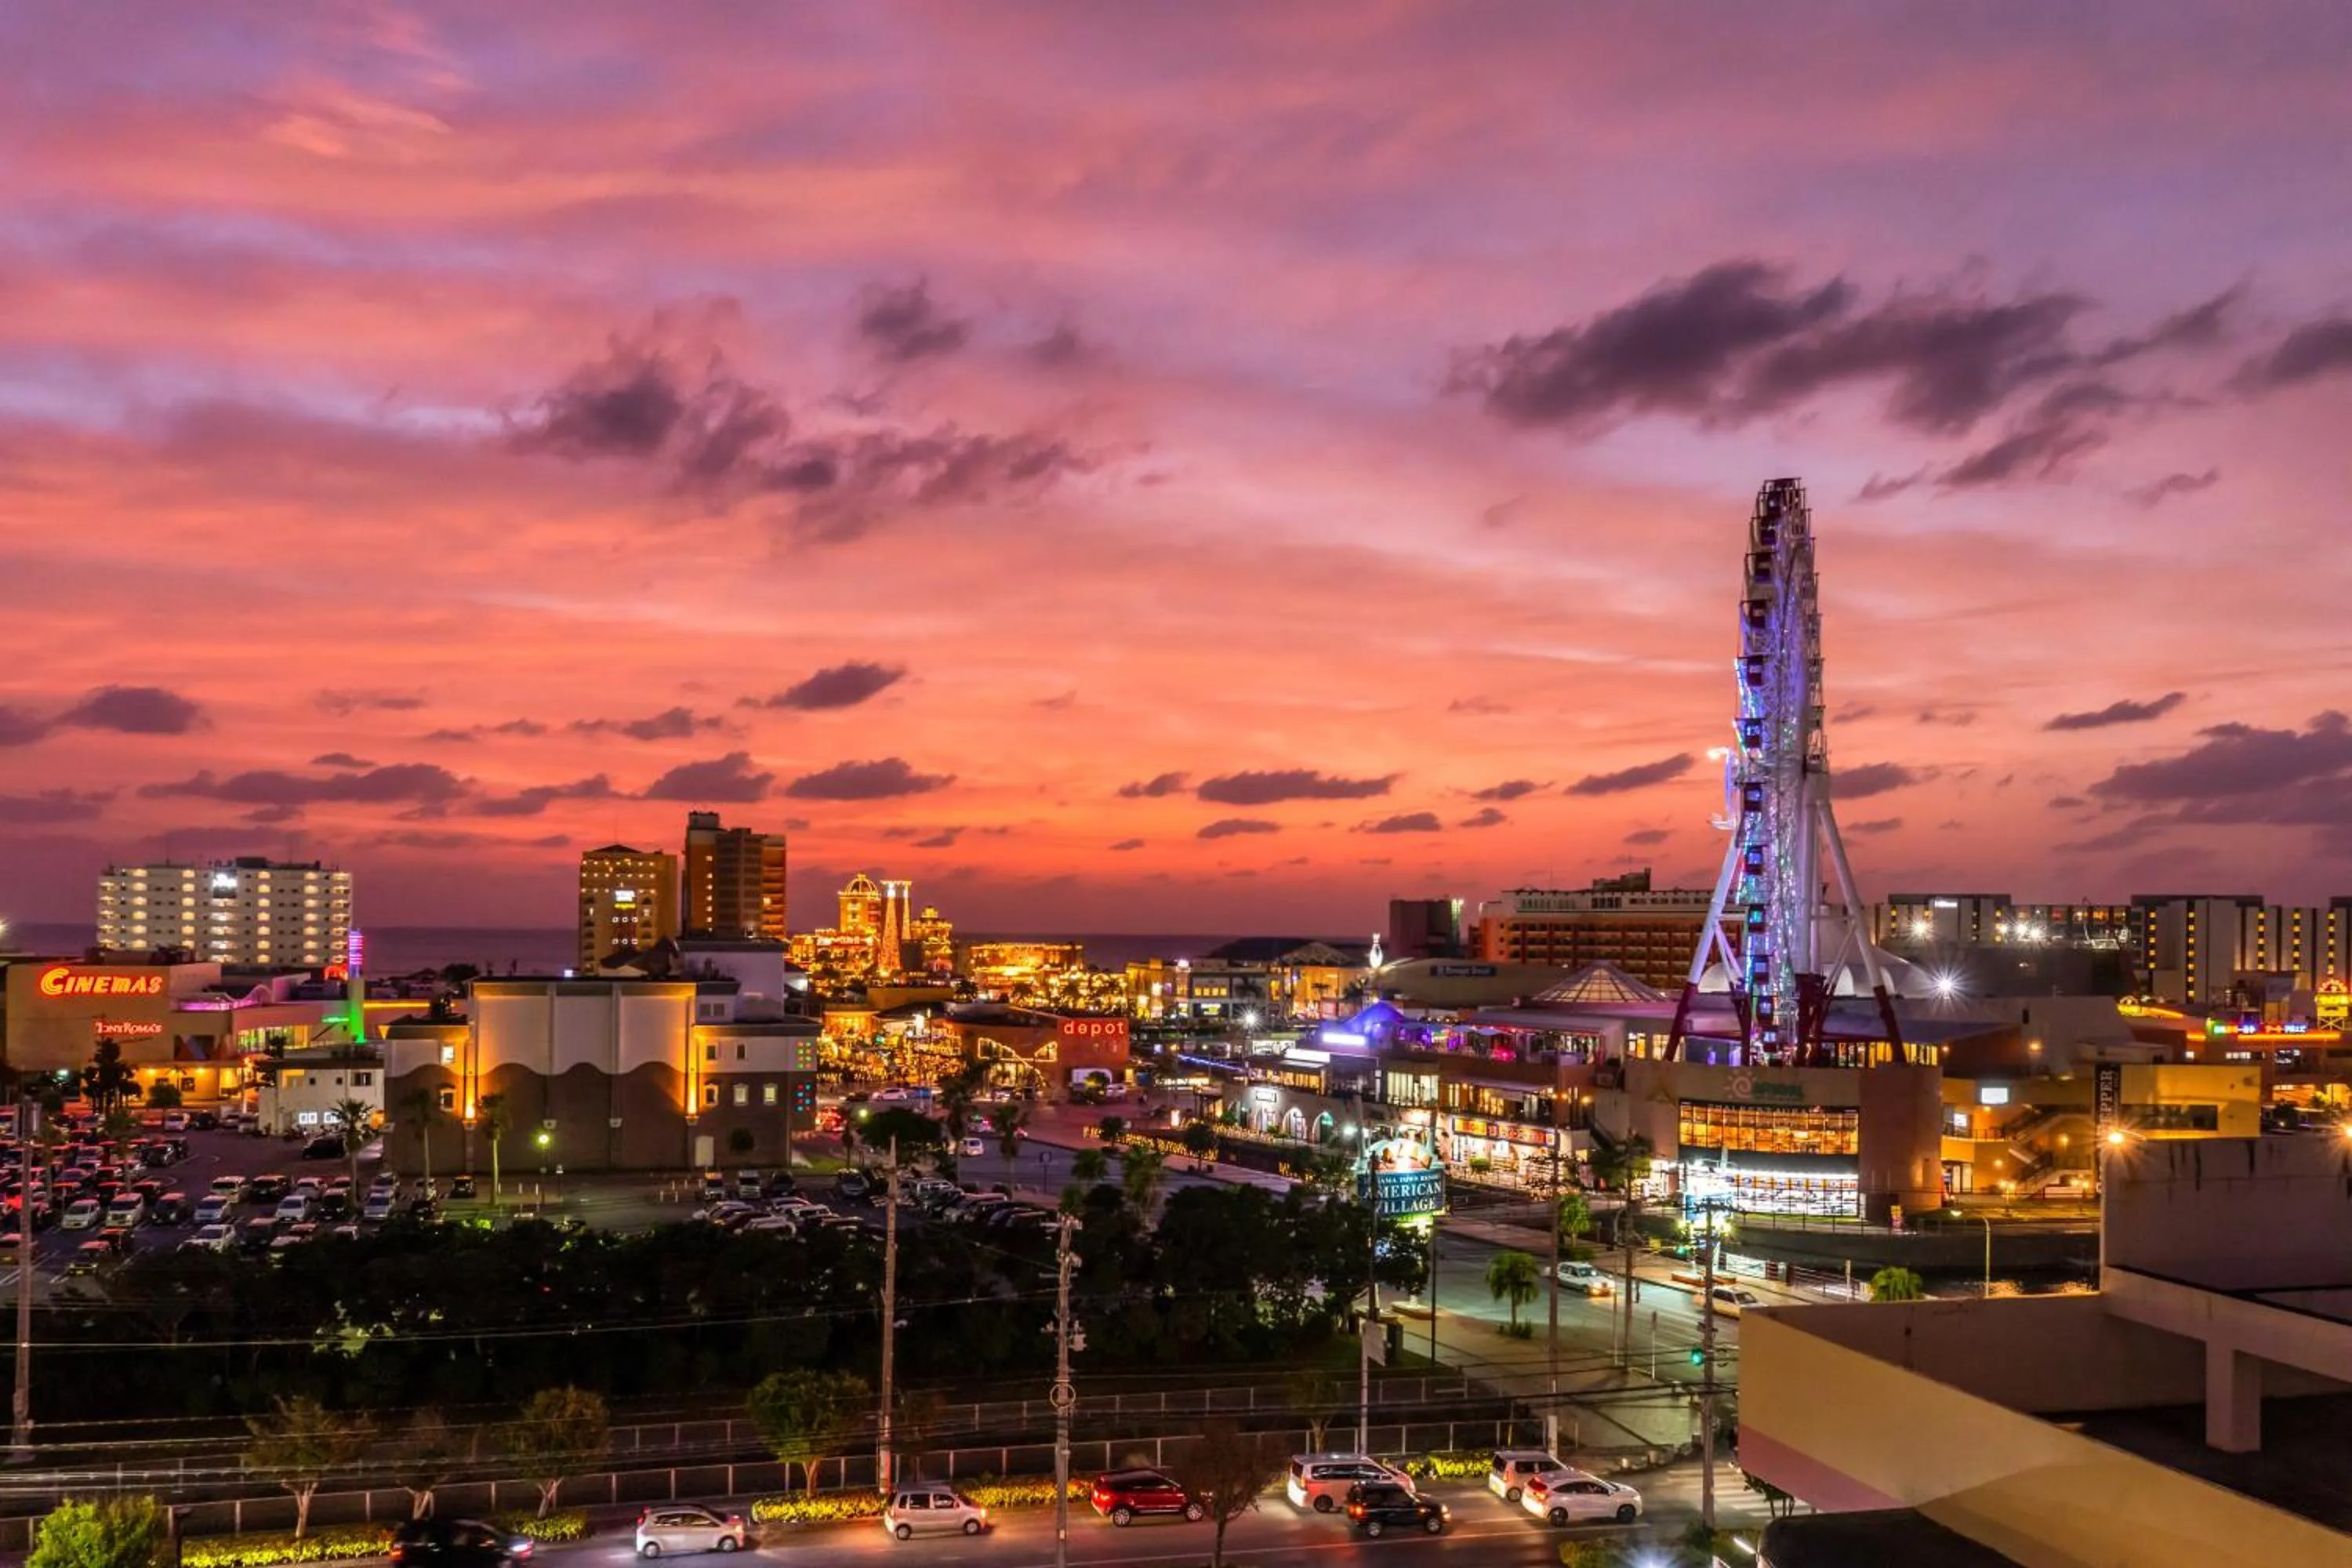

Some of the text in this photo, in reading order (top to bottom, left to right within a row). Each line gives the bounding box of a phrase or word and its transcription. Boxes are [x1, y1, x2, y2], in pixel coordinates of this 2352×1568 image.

[40, 967, 163, 996] CINEMAS
[1064, 1020, 1124, 1036] depot
[1363, 1181, 1442, 1199] AMERICAN
